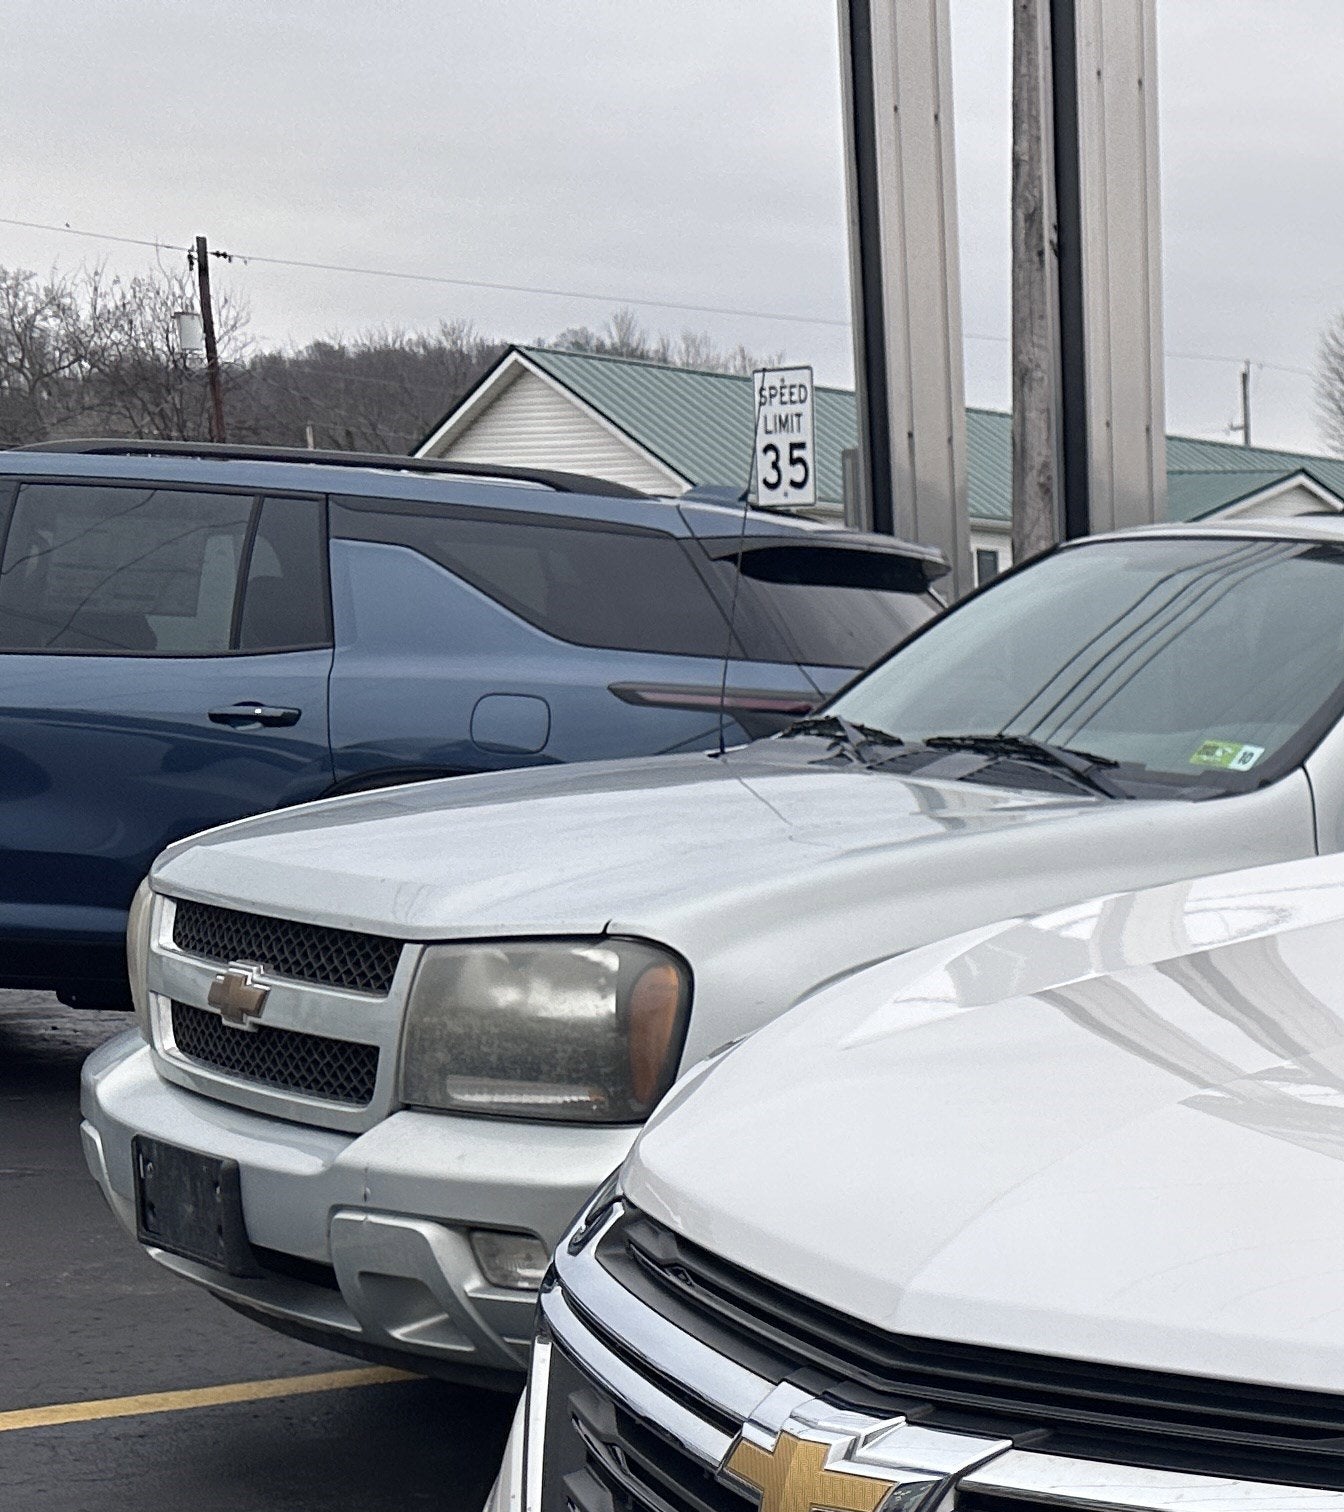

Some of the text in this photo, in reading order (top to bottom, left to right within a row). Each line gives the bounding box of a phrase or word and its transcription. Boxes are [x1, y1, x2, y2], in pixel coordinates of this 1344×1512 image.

[758, 383, 808, 407] SPEED
[763, 412, 803, 435] LIMIT
[762, 442, 809, 490] 35
